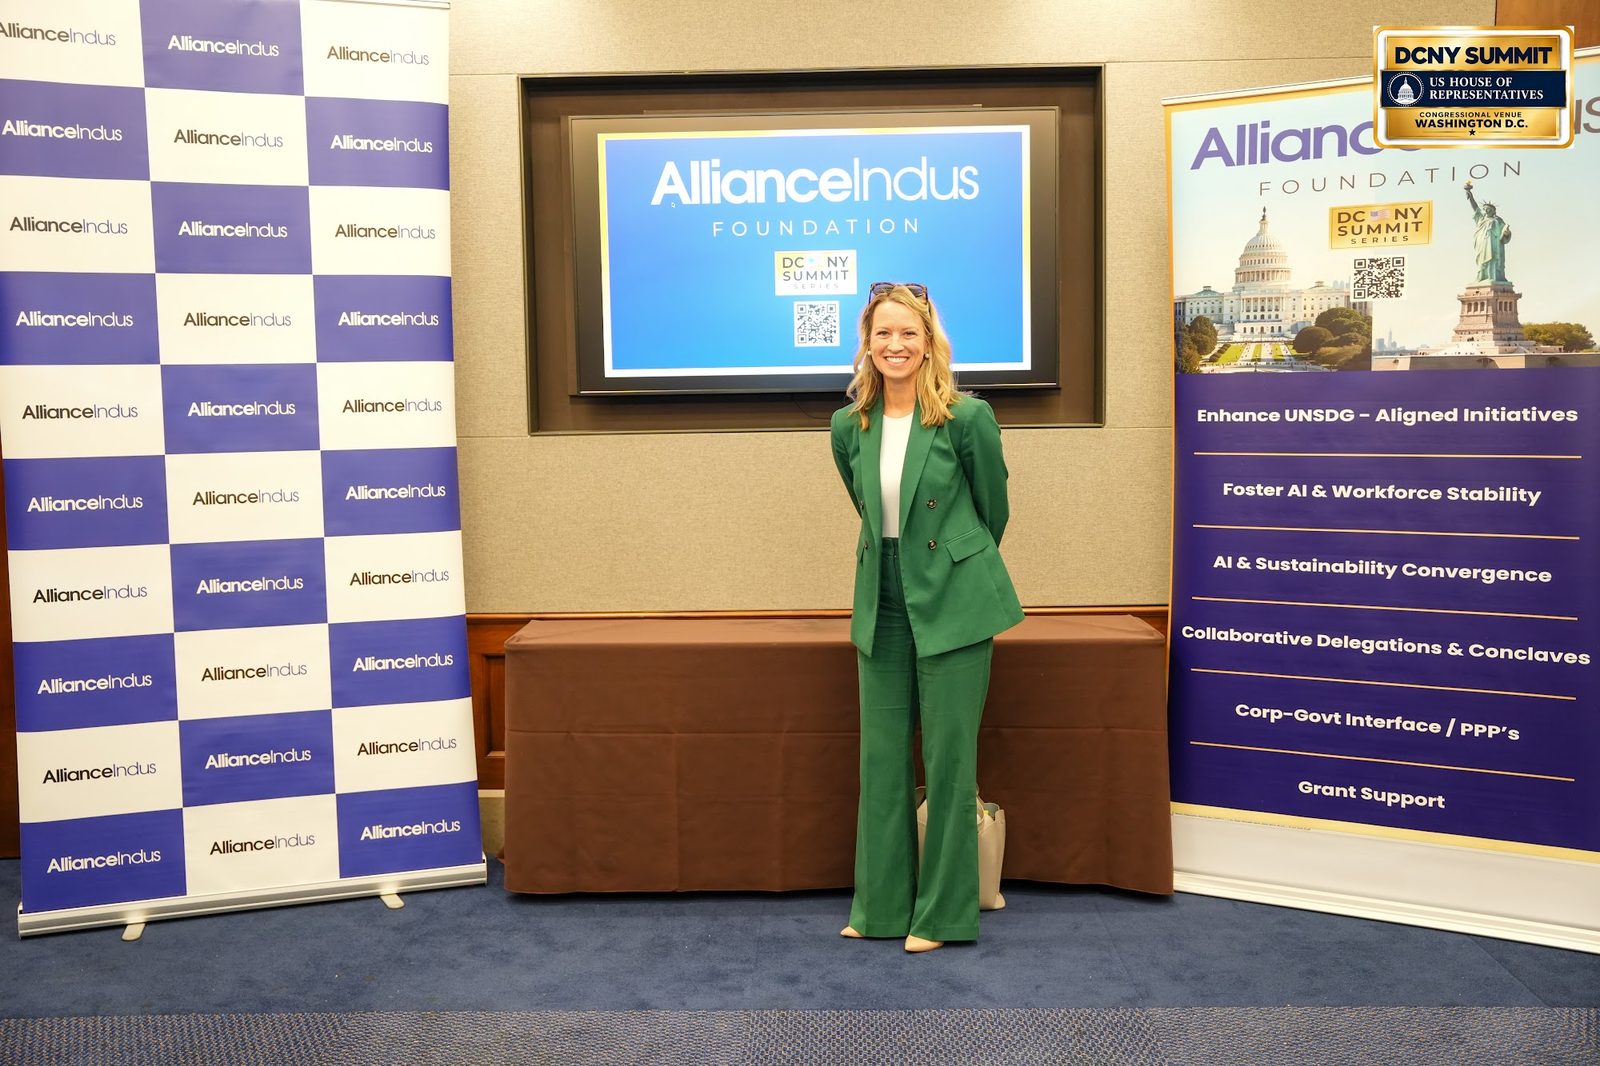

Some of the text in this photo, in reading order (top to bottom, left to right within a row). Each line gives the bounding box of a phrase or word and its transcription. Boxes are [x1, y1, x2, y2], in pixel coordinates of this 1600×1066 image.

[167, 35, 280, 56] AllianceIndus
[326, 46, 430, 65] AllianceIndus
[1, 120, 123, 141] AllianceIndus
[173, 129, 284, 147] AllianceIndus
[330, 135, 433, 152] AllianceIndus
[650, 156, 980, 206] AllianceIndus
[1259, 160, 1522, 196] FOUNDATION
[1337, 206, 1423, 224] DC NY
[9, 216, 129, 234] AllianceIndus
[177, 220, 288, 238] AllianceIndus
[334, 223, 436, 240] AllianceIndus
[713, 218, 919, 237] FOUNDATION
[1337, 221, 1423, 237] SUMMIT
[1350, 235, 1409, 245] SERIES
[782, 256, 849, 269] DC NY
[783, 270, 849, 282] SUMMIT
[15, 310, 134, 327] AllianceIndus
[183, 311, 292, 327] AllianceIndus
[337, 310, 439, 327] AllianceIndus
[21, 403, 139, 420] AllianceIndus
[187, 400, 296, 417] AllianceIndus
[341, 398, 443, 414] AllianceIndus
[1198, 408, 1280, 423] Enhance
[1285, 407, 1354, 423] UNSDG
[1375, 407, 1457, 426] Aligned
[1464, 406, 1577, 421] Initiatives
[192, 488, 300, 506] AllianceIndus
[345, 483, 446, 500] AllianceIndus
[1224, 482, 1541, 506] Foster AI & Workforce Stability
[26, 494, 144, 512] AllianceIndus
[349, 569, 450, 586] AllianceIndus
[1214, 555, 1551, 584] AI & Sustainability Convergence
[32, 585, 148, 603] AllianceIndus
[196, 576, 304, 594] AllianceIndus
[1182, 625, 1590, 664] Collaborative Delegations & Conclaves
[352, 653, 454, 672] AllianceIndus
[200, 662, 308, 682] AllianceIndus
[37, 673, 153, 694] AllianceIndus
[1346, 712, 1441, 733] Interface
[1446, 717, 1455, 737] /
[356, 737, 458, 756] AllianceIndus
[204, 748, 312, 769] AllianceIndus
[41, 762, 157, 784] AllianceIndus
[1299, 780, 1445, 808] Grant Support
[359, 819, 461, 840] AllianceIndus
[209, 834, 316, 855] AllianceIndus
[46, 849, 162, 873] AllianceIndus
